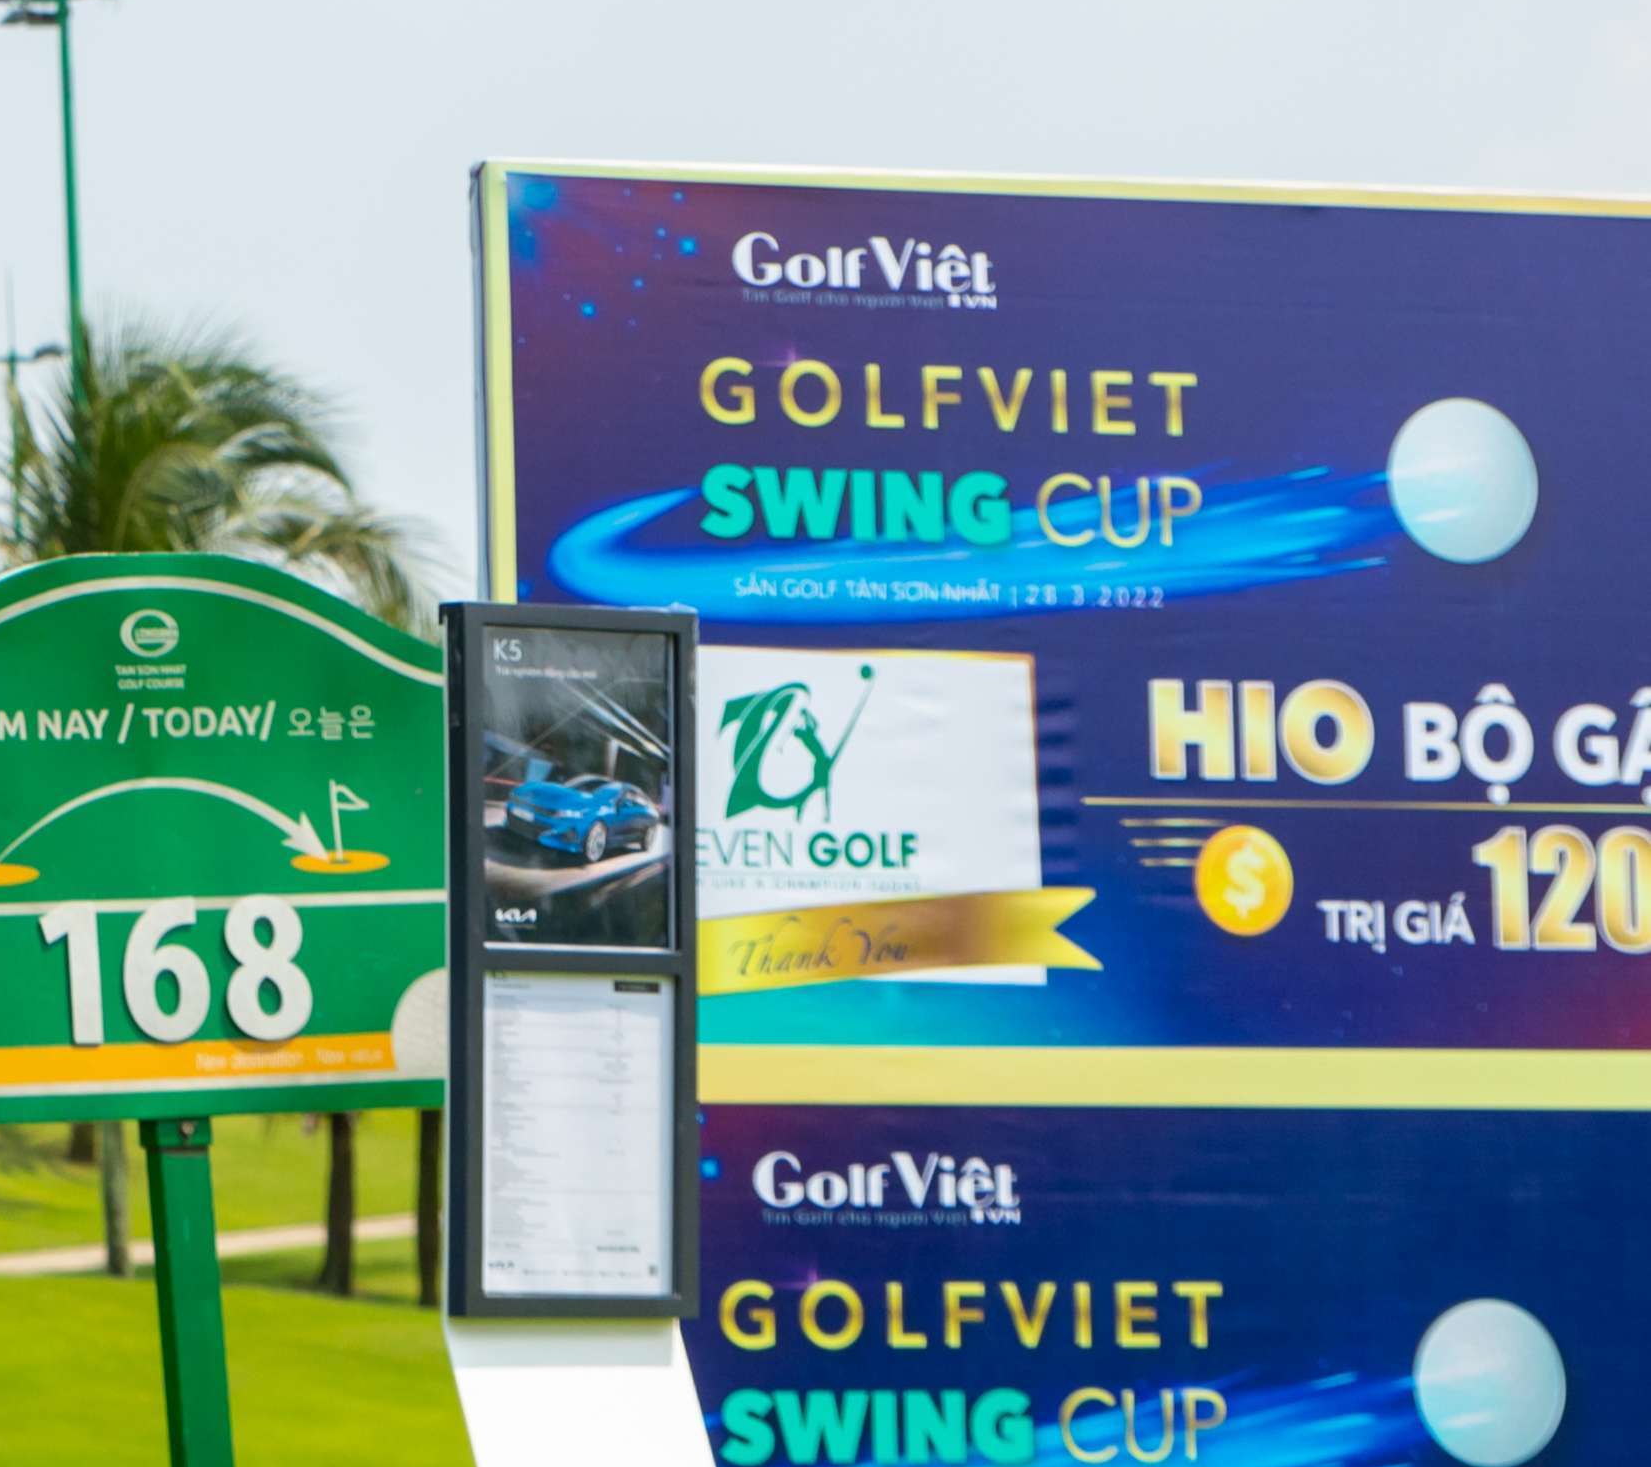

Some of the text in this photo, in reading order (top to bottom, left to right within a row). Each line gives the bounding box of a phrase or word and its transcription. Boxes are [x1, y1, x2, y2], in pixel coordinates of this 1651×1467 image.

[732, 231, 868, 288] Golf
[700, 356, 1198, 436] GOLFVIET
[700, 463, 1203, 548] SWING CUP
[782, 579, 837, 600] GOLF
[493, 638, 523, 661] K5
[37, 709, 109, 741] NAY
[287, 704, 376, 741] 오늘은
[1148, 678, 1375, 784] HIO
[1402, 682, 1534, 805] BỘ
[695, 828, 918, 868] EVEN GOLF
[728, 915, 909, 976] Thank You
[1316, 898, 1386, 954] TRỊ
[1392, 890, 1475, 945] GIÁ
[37, 894, 313, 1046] 168
[752, 1150, 891, 1208] Golf
[718, 1279, 1223, 1351] GOLFVIET
[719, 1386, 1227, 1467] SWING CUP
